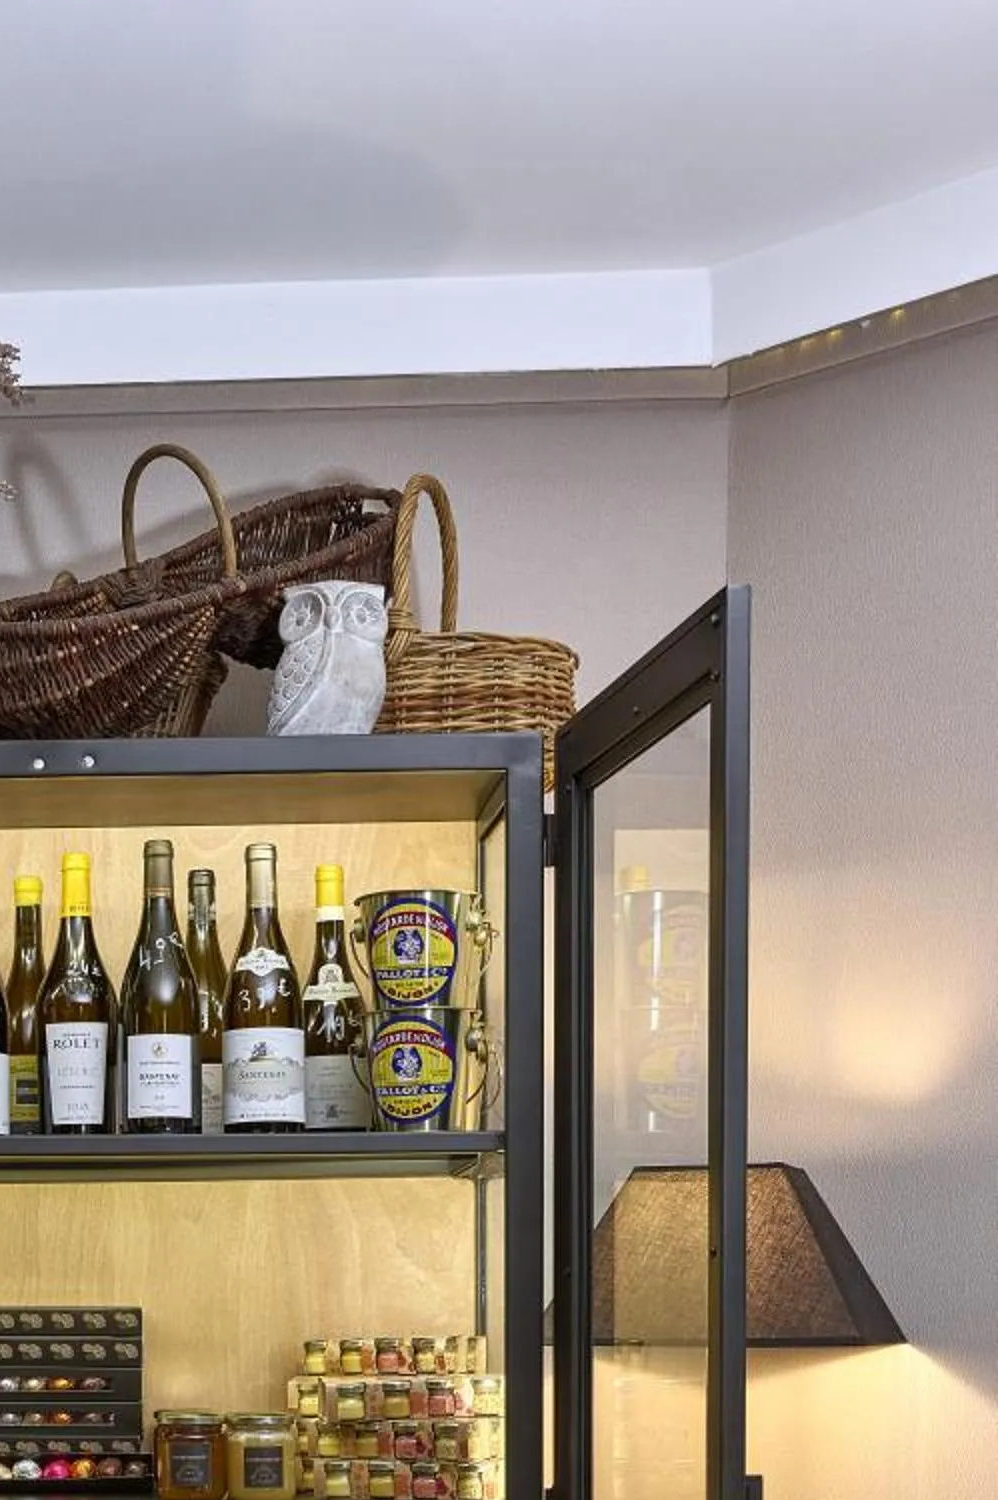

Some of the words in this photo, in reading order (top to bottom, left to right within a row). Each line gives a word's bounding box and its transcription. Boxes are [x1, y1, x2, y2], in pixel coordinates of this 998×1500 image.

[387, 984, 433, 998] DIJON
[53, 1038, 101, 1050] ROLET
[387, 1102, 433, 1116] DIJON
